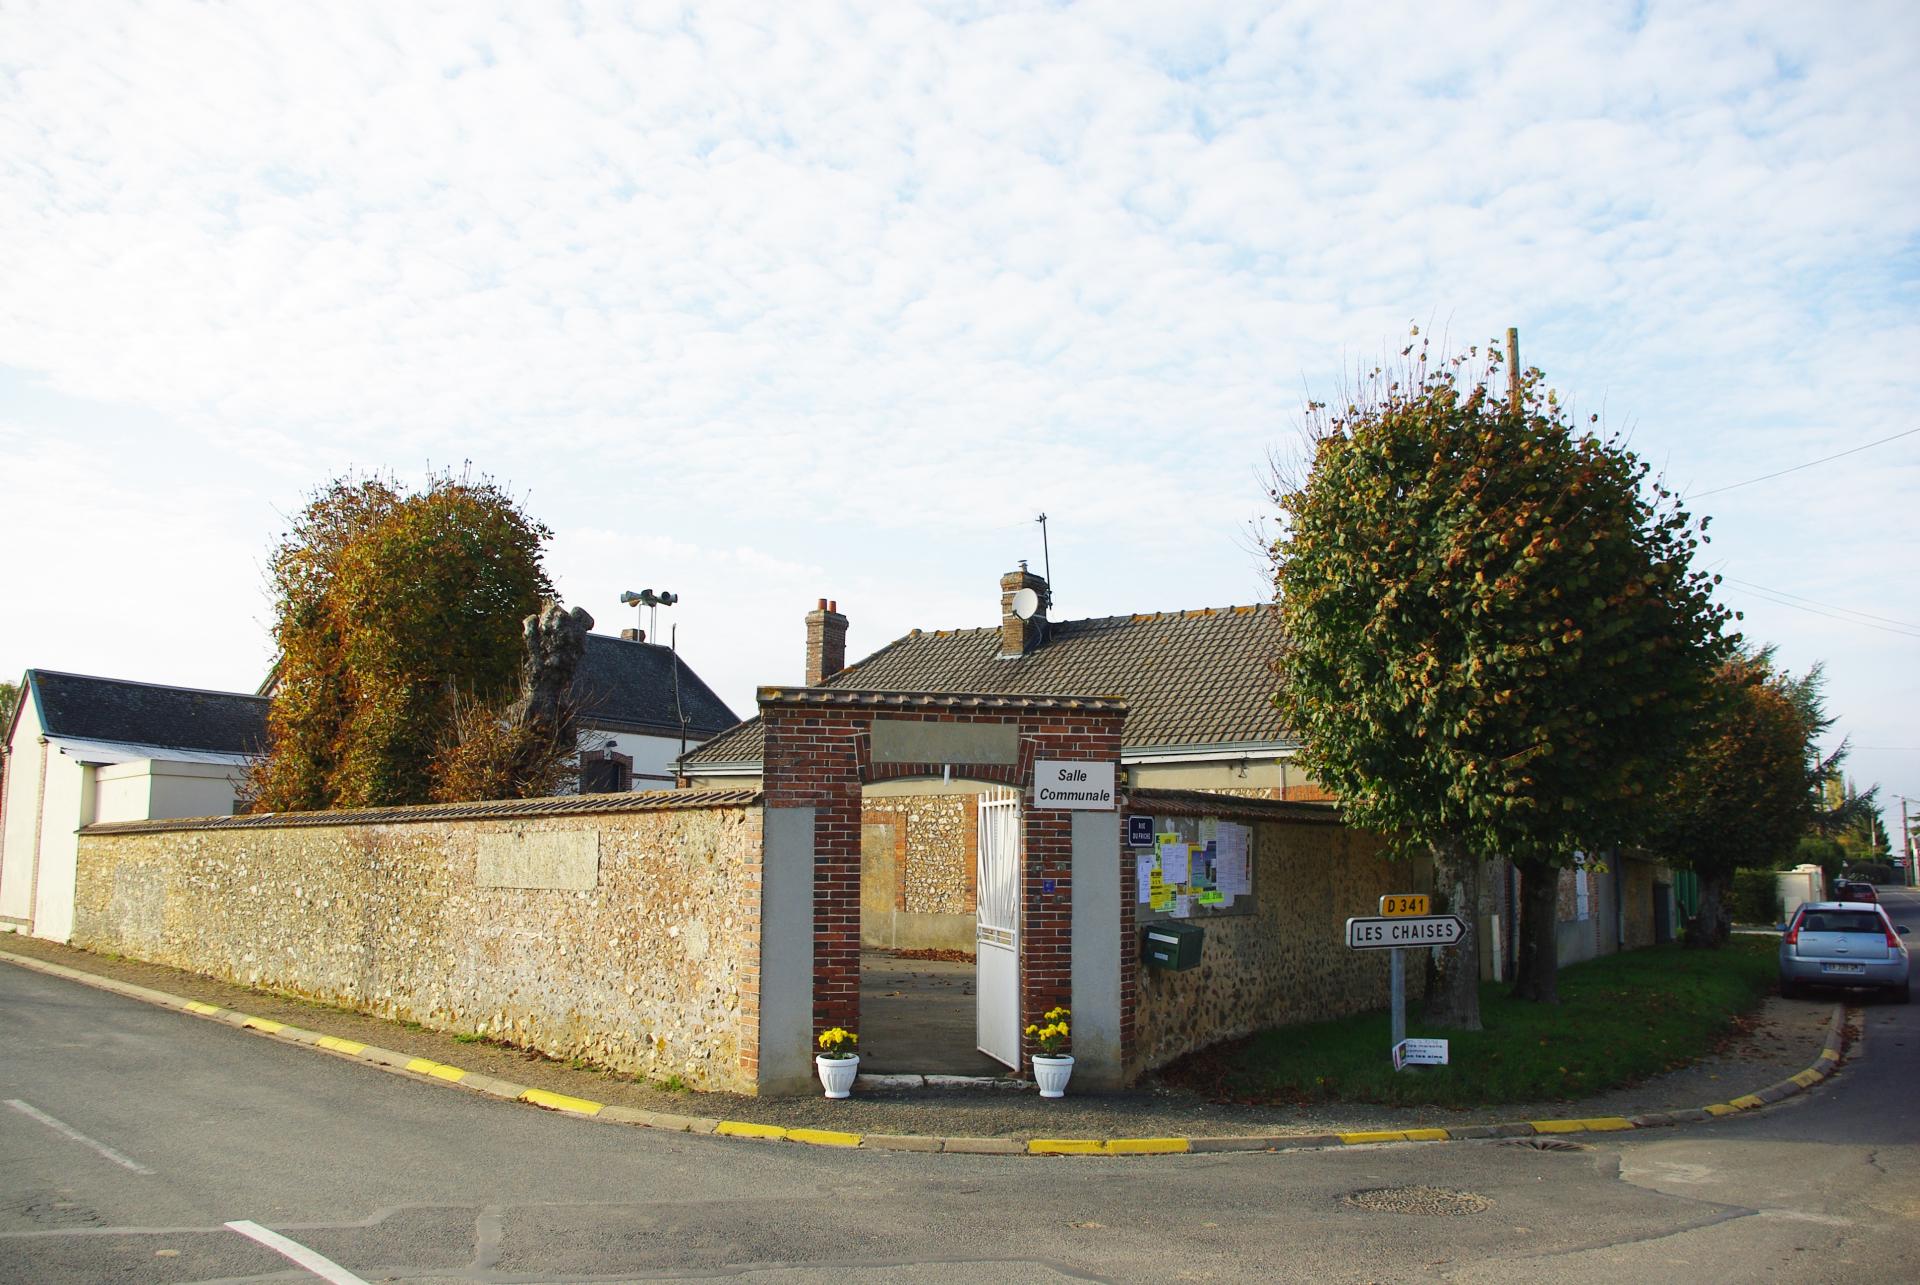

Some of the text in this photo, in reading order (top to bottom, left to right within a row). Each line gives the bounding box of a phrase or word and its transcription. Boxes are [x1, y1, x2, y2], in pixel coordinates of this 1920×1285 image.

[1058, 769, 1087, 781] Salle
[1040, 788, 1110, 801] Communale
[1388, 899, 1424, 912] D 341
[1357, 923, 1453, 941] LES CHAISES
